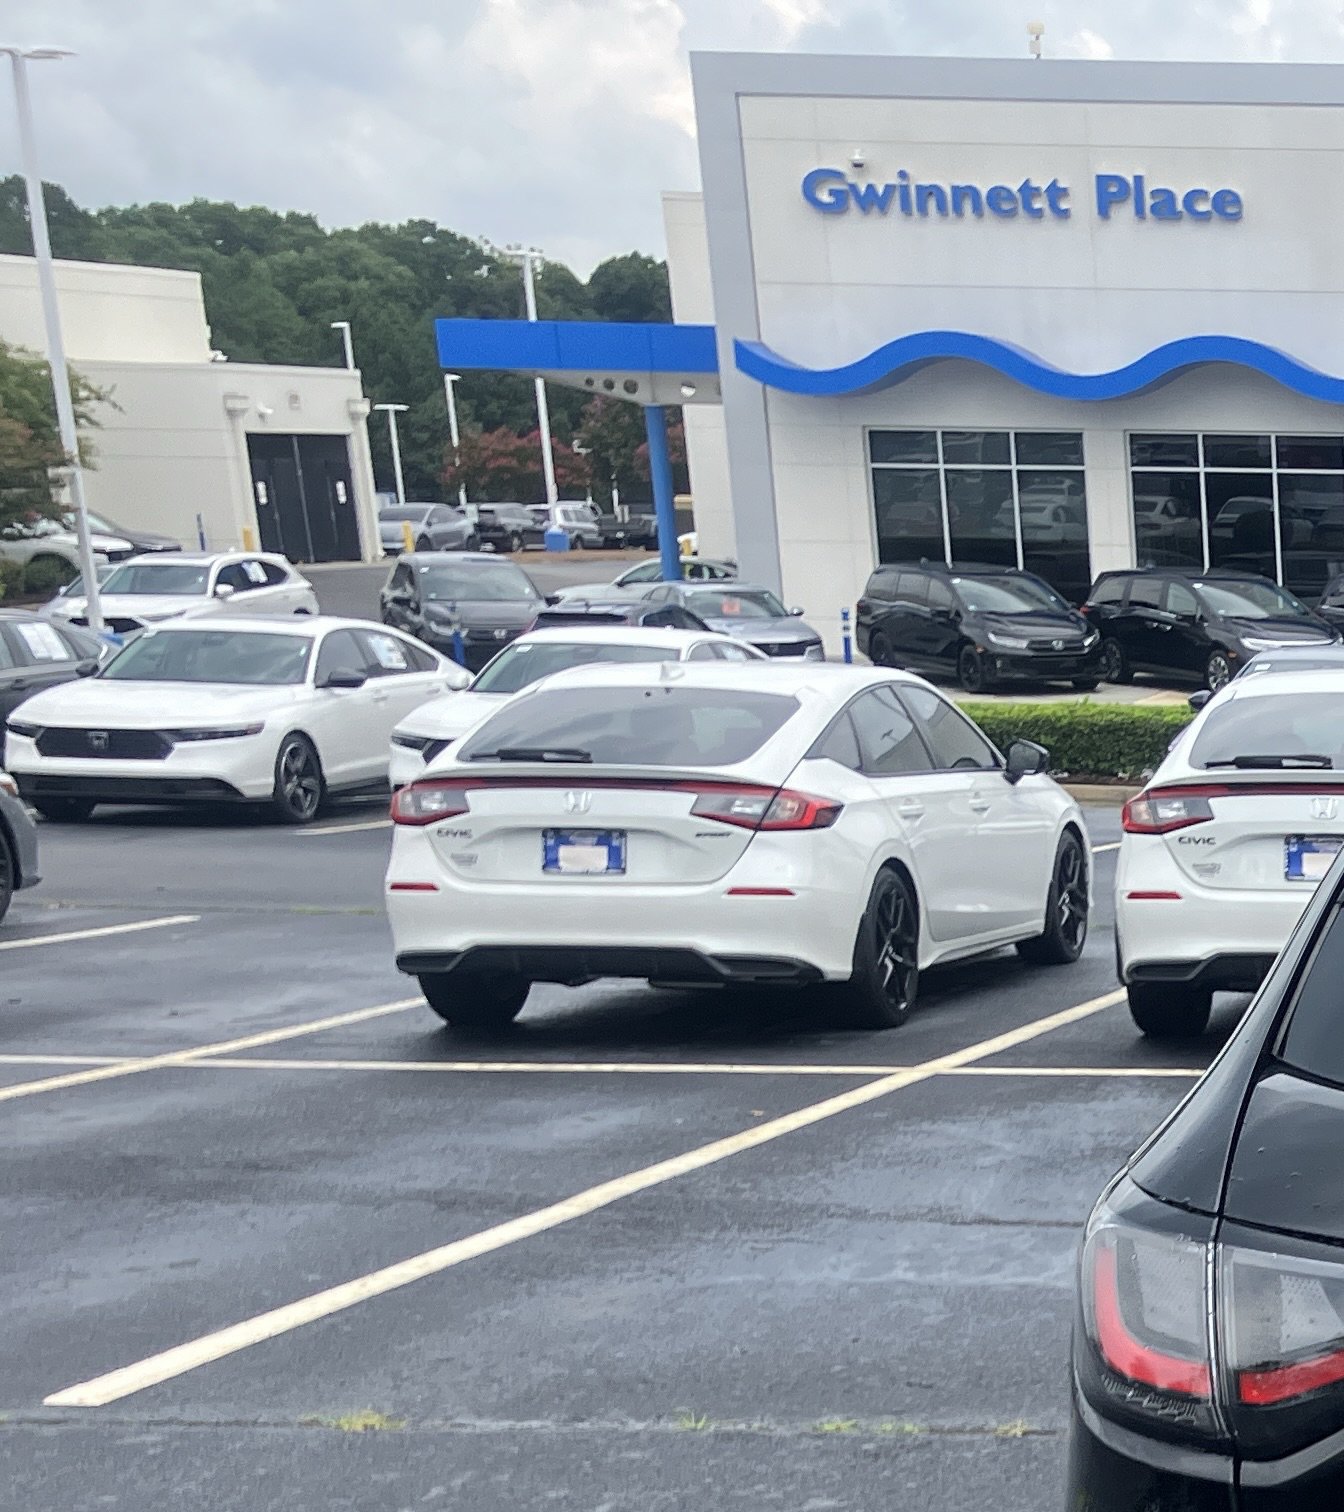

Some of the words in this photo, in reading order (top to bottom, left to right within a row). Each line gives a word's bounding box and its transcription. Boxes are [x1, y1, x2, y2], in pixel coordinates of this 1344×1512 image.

[801, 167, 1072, 218] Gwinnett
[1095, 173, 1244, 221] Place
[1178, 836, 1217, 845] CIVIC
